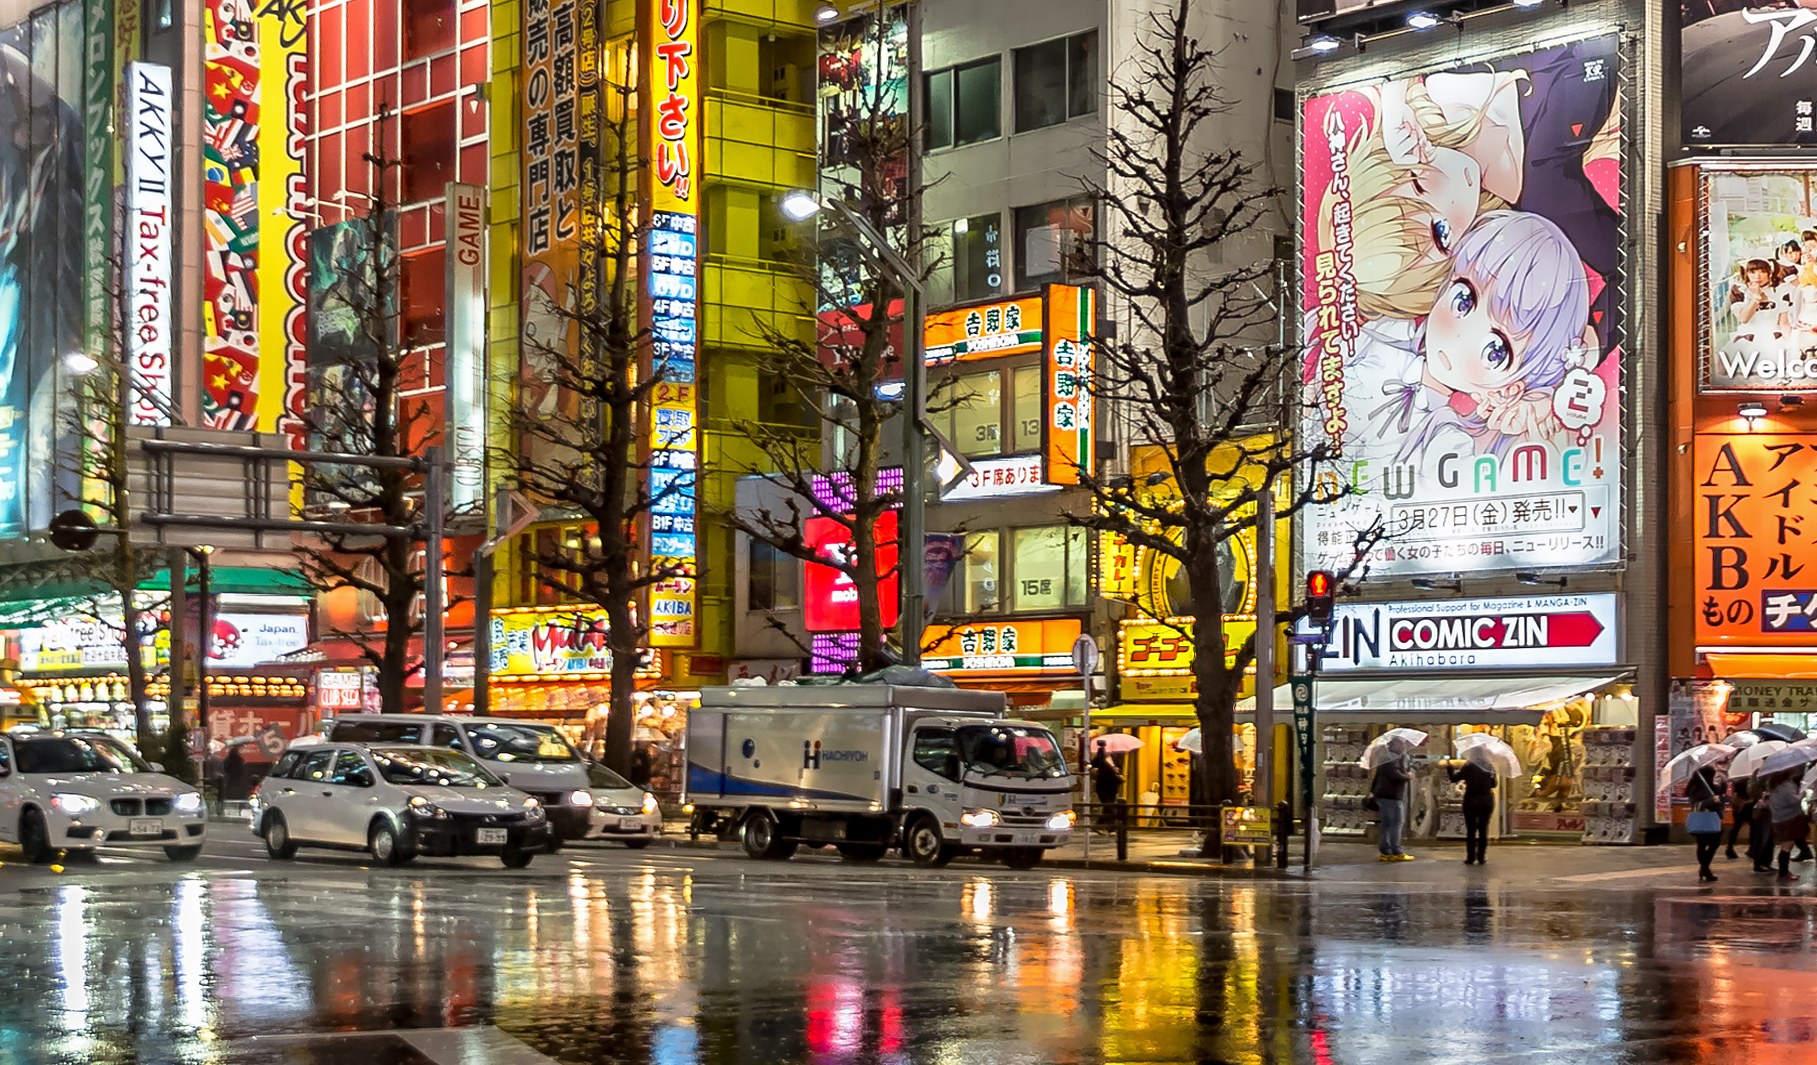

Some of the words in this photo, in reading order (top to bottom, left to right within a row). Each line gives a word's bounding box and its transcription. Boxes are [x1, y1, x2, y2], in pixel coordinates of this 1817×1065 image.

[551, 1, 578, 243] 高額買取と
[458, 194, 480, 268] GAME
[138, 204, 167, 345] Tax-free
[965, 305, 1022, 336] 吉野家
[1054, 338, 1077, 433] 吉野家
[1763, 441, 1805, 582] アイドル
[655, 599, 693, 616] AKIBA
[1391, 616, 1496, 650] COMIC
[1501, 615, 1549, 647] ZIN
[1389, 653, 1476, 667] Akihabara
[1733, 686, 1782, 697] MONEY
